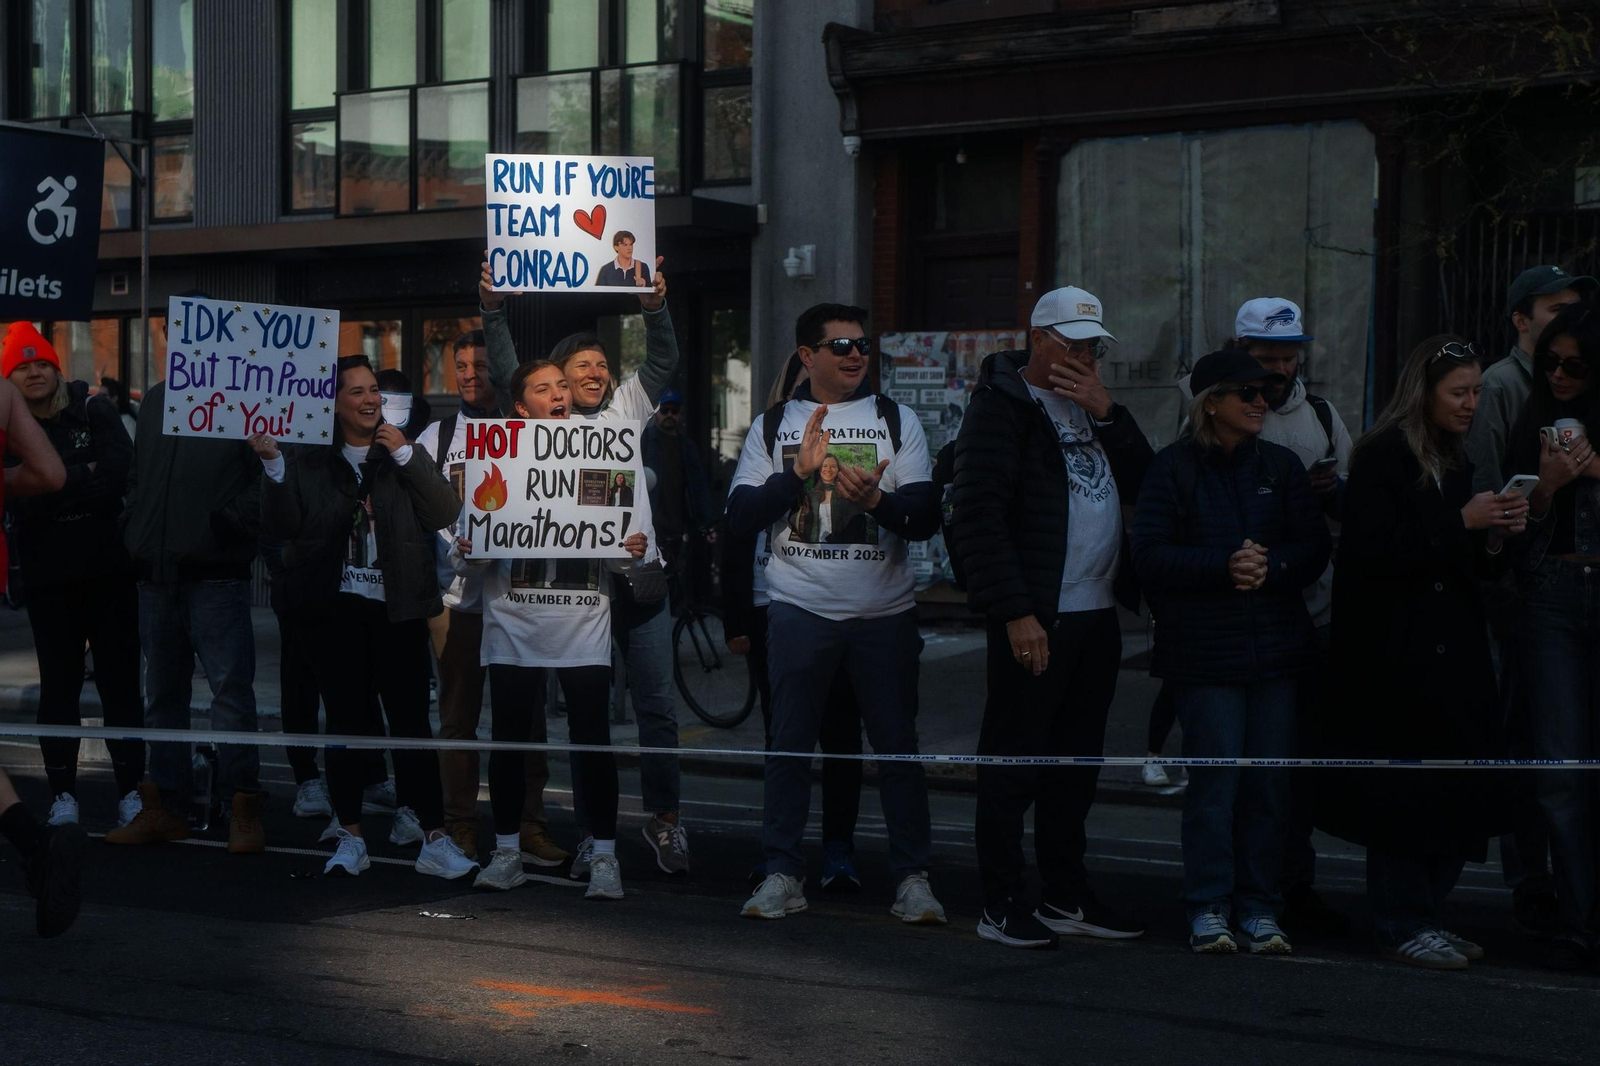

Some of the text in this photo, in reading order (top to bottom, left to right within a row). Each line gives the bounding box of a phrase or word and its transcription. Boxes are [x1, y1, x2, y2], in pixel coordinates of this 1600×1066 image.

[494, 159, 544, 194] RUN
[555, 160, 579, 196] IF
[488, 203, 561, 237] TEAM
[491, 247, 589, 289] CONRAD
[181, 301, 315, 350] IDK YOU
[169, 351, 337, 399] But I'm Proud
[1109, 360, 1162, 380] THE
[188, 392, 294, 436] of You!
[466, 421, 634, 462] HOT DOCTORS
[526, 467, 575, 501] RUN
[468, 507, 632, 554] Marathons!
[781, 546, 886, 561] NOVEMBER 2025
[505, 591, 571, 605] NOVEMBER
